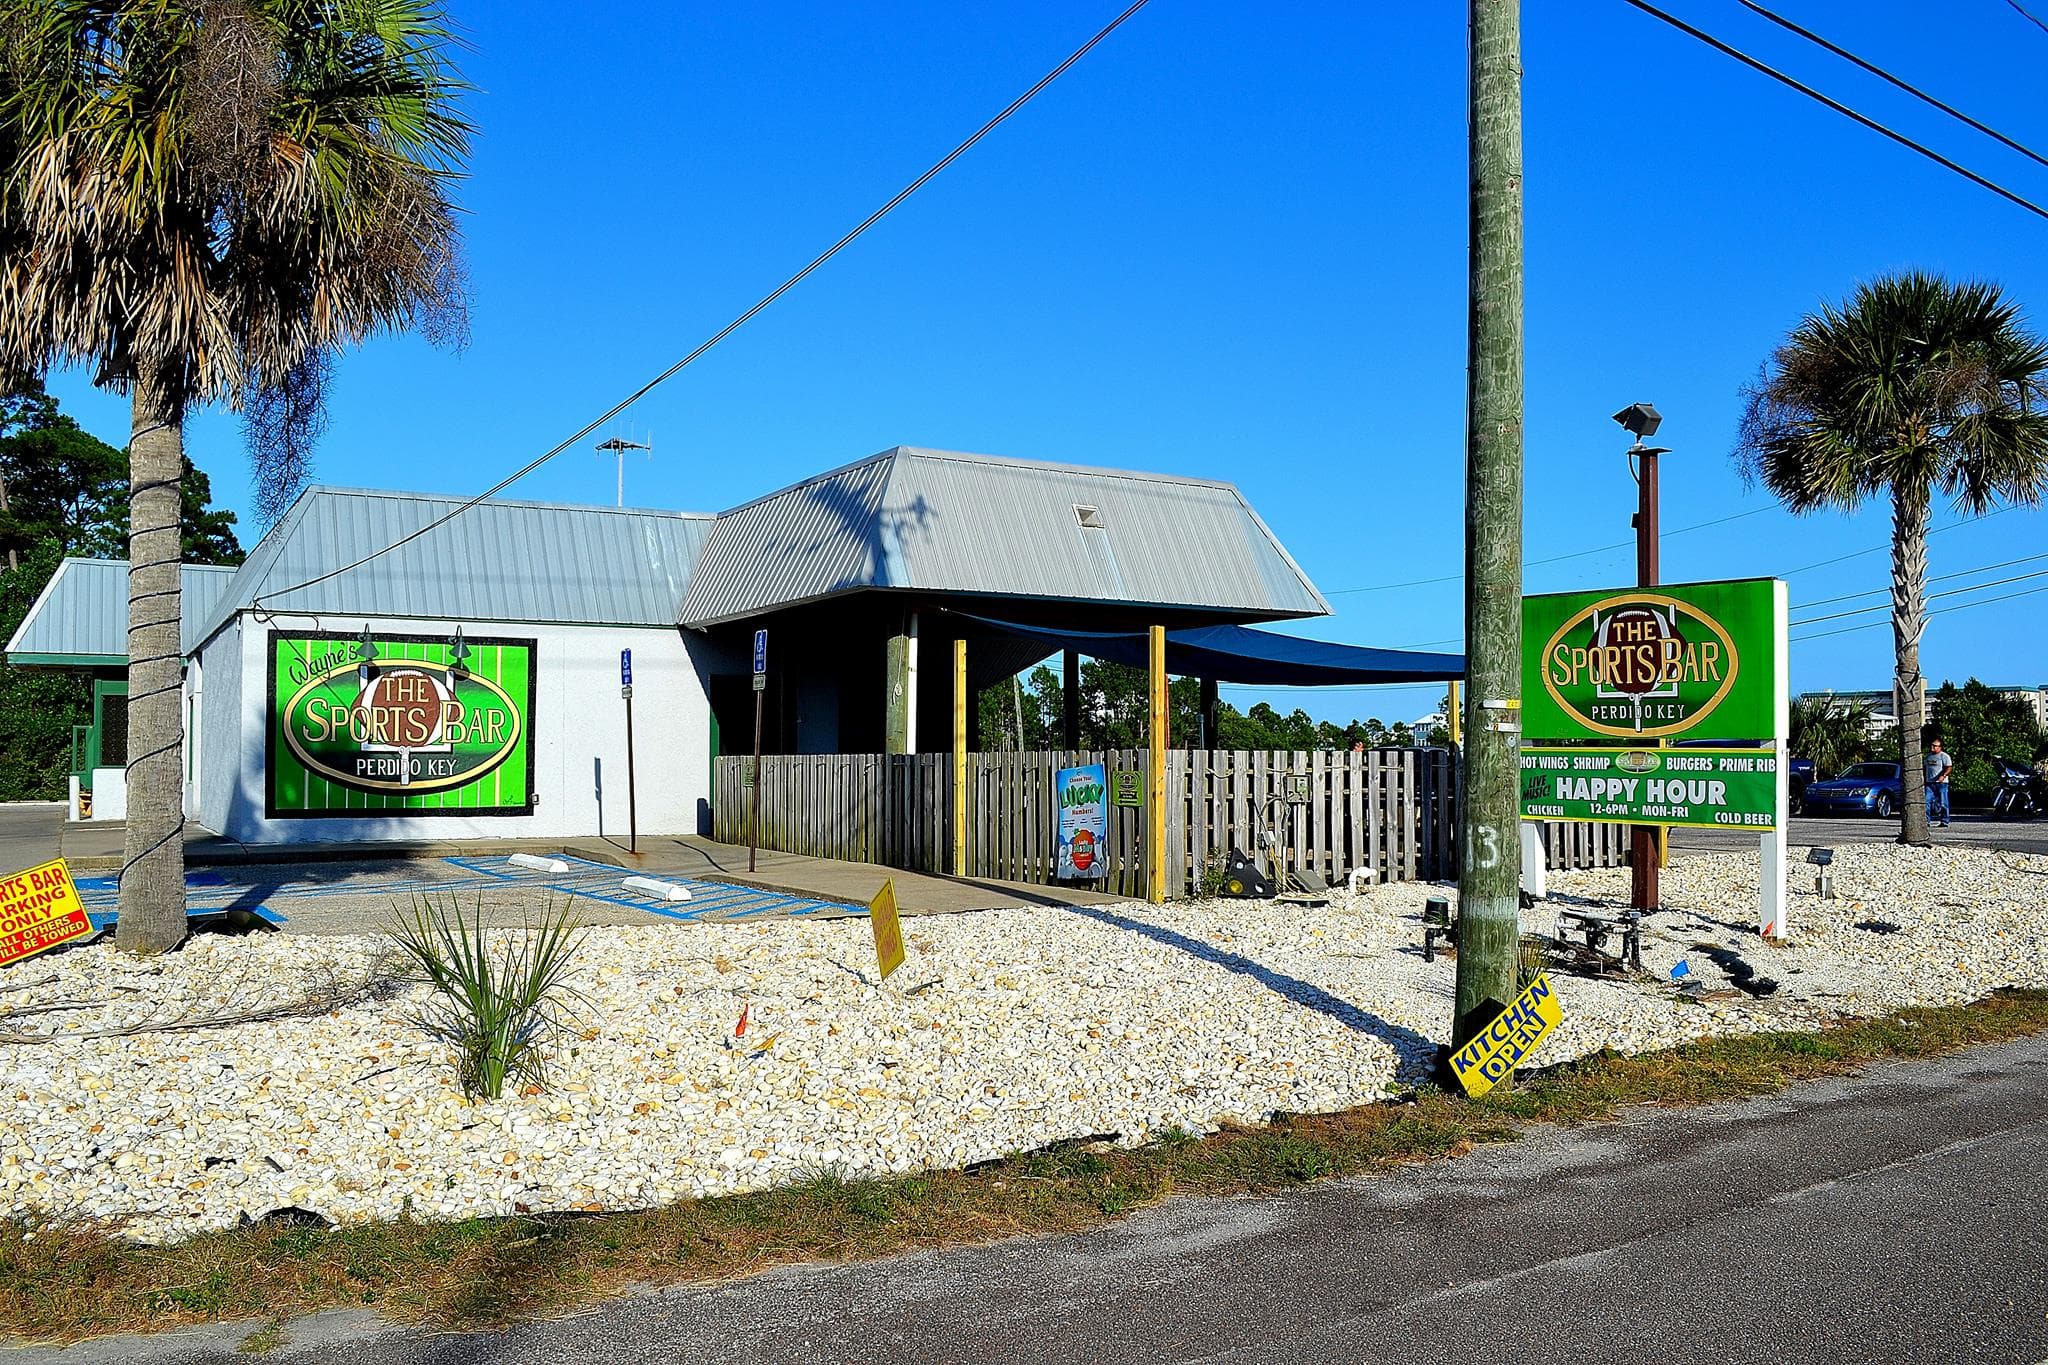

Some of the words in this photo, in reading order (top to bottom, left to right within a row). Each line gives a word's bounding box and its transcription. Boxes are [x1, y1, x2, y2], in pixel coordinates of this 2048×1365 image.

[1613, 621, 1657, 642] THE
[289, 641, 358, 686] Wayne's
[1552, 643, 1656, 686] SPORTS
[1658, 638, 1721, 683] BAR
[382, 677, 429, 703] THE
[302, 697, 428, 743] SPORTS
[439, 700, 506, 744] BAR
[1591, 704, 1652, 720] PERDIDO
[1657, 704, 1686, 720] KEY
[356, 758, 421, 776] PERDIDO
[427, 758, 457, 776] KEY
[1519, 756, 1537, 769] HOT
[1538, 756, 1569, 770] WINGS
[1573, 756, 1611, 770] SHRIMP
[1666, 757, 1713, 771] BURGERS
[1719, 758, 1754, 772] PRIME
[1756, 758, 1776, 772] RIB
[1528, 775, 1547, 789] LIVE
[1556, 777, 1639, 802] HAPPY
[1647, 779, 1727, 805] HOUR
[1060, 783, 1105, 809] LUCKY
[1527, 804, 1564, 816] CHICKEN
[1590, 803, 1629, 815] 12-6PM
[1641, 805, 1689, 818] MON-FRI
[1714, 812, 1742, 823] COLD
[1744, 813, 1773, 826] BEER
[29, 868, 67, 891] BAR
[1, 905, 52, 932] ONLY
[22, 916, 71, 940] OTHERS
[22, 937, 39, 951] BE
[40, 921, 85, 943] TOWED
[1453, 978, 1550, 1075] KITCHEN
[1485, 1015, 1544, 1078] OPEN
